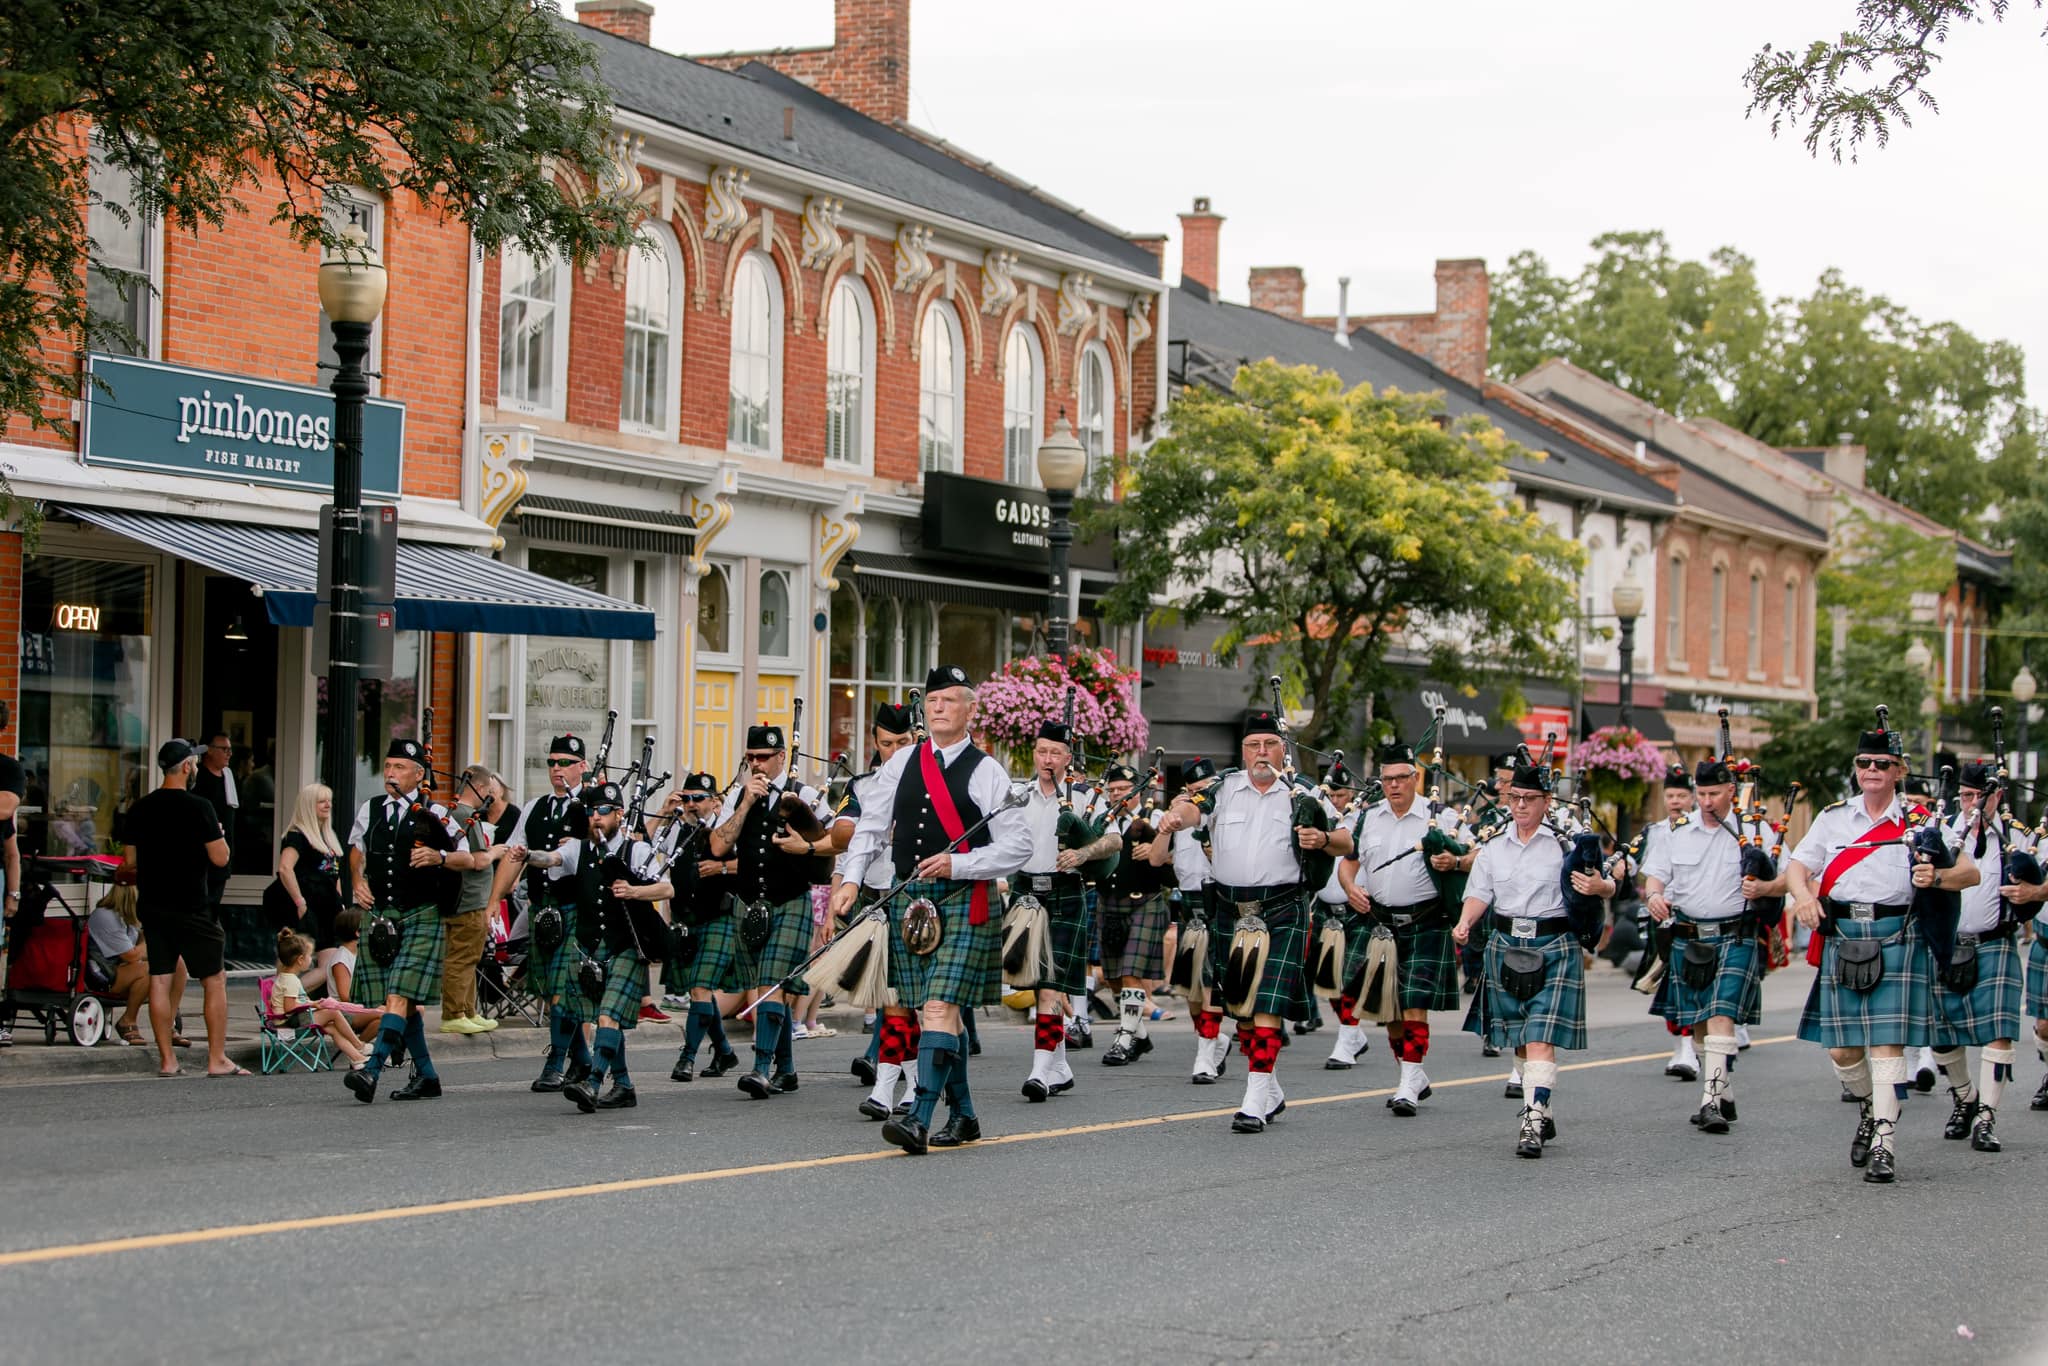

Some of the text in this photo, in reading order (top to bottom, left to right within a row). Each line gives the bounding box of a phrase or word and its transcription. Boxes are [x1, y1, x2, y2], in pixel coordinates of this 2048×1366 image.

[176, 389, 330, 451] pinbones
[205, 449, 300, 473] FISH MARKET
[995, 498, 1050, 528] GADSB
[1012, 531, 1043, 547] CLOTHING
[57, 604, 100, 631] OPEN
[762, 609, 775, 626] 61
[533, 648, 600, 681] DUNDAS
[1178, 651, 1201, 670] spoon
[526, 685, 607, 709] LAW OFFICE
